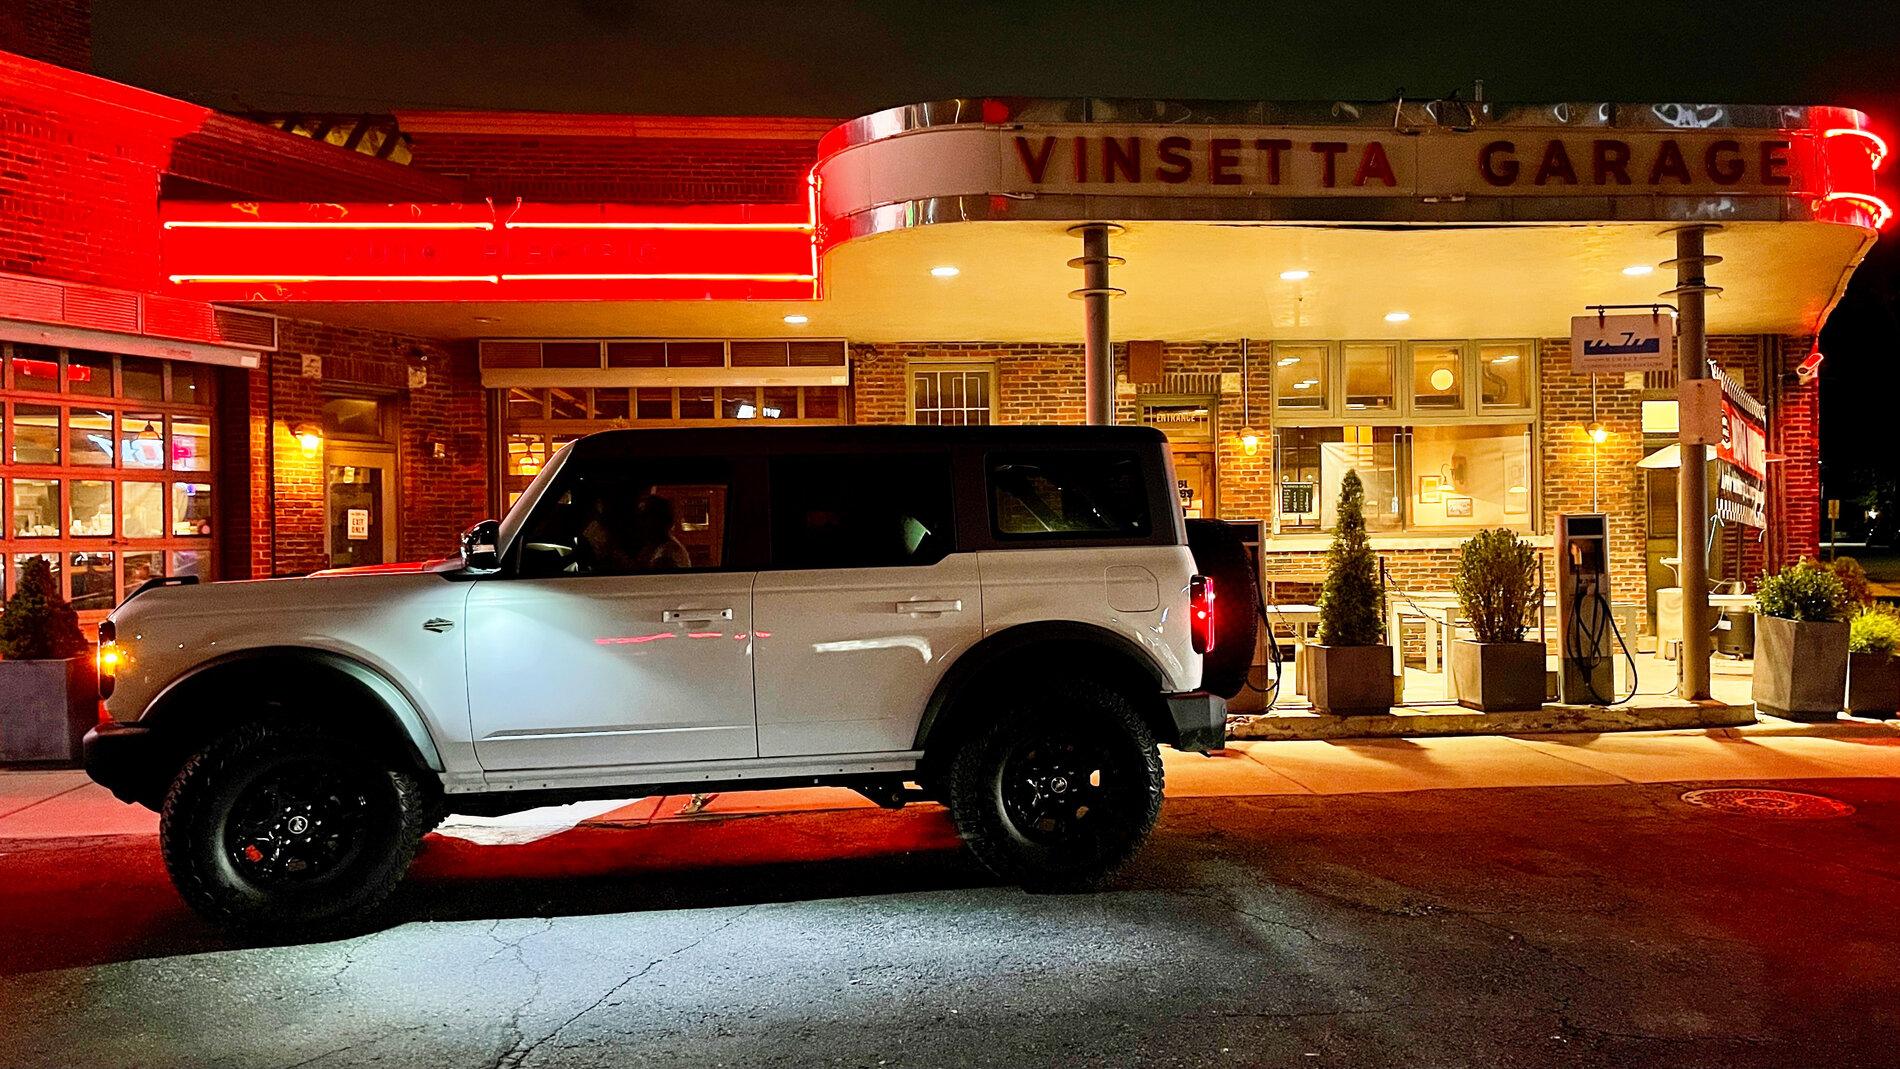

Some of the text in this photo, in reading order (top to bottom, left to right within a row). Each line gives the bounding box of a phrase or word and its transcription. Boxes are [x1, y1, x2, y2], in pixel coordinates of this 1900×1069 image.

[1014, 136, 1793, 187] VINSETTA GARAGE
[1156, 413, 1196, 423] ENTRANCE
